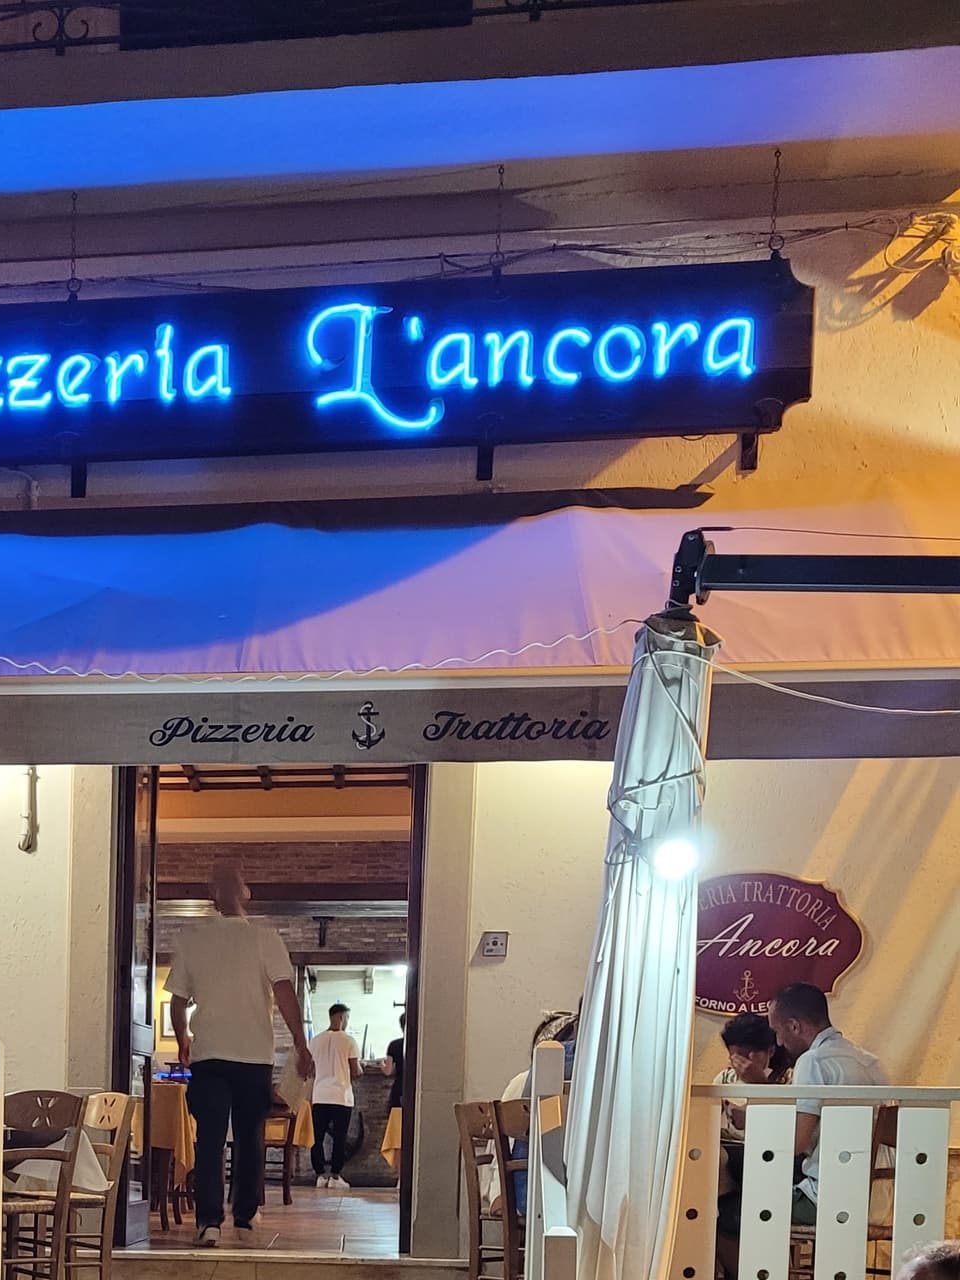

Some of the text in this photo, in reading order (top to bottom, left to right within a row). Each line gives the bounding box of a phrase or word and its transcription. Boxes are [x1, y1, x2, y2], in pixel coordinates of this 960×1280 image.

[304, 301, 758, 430] L'ancora
[148, 710, 611, 747] Pizzeria Trattoria
[741, 881, 838, 931] TRATTORIA
[738, 1003, 748, 1013] A
